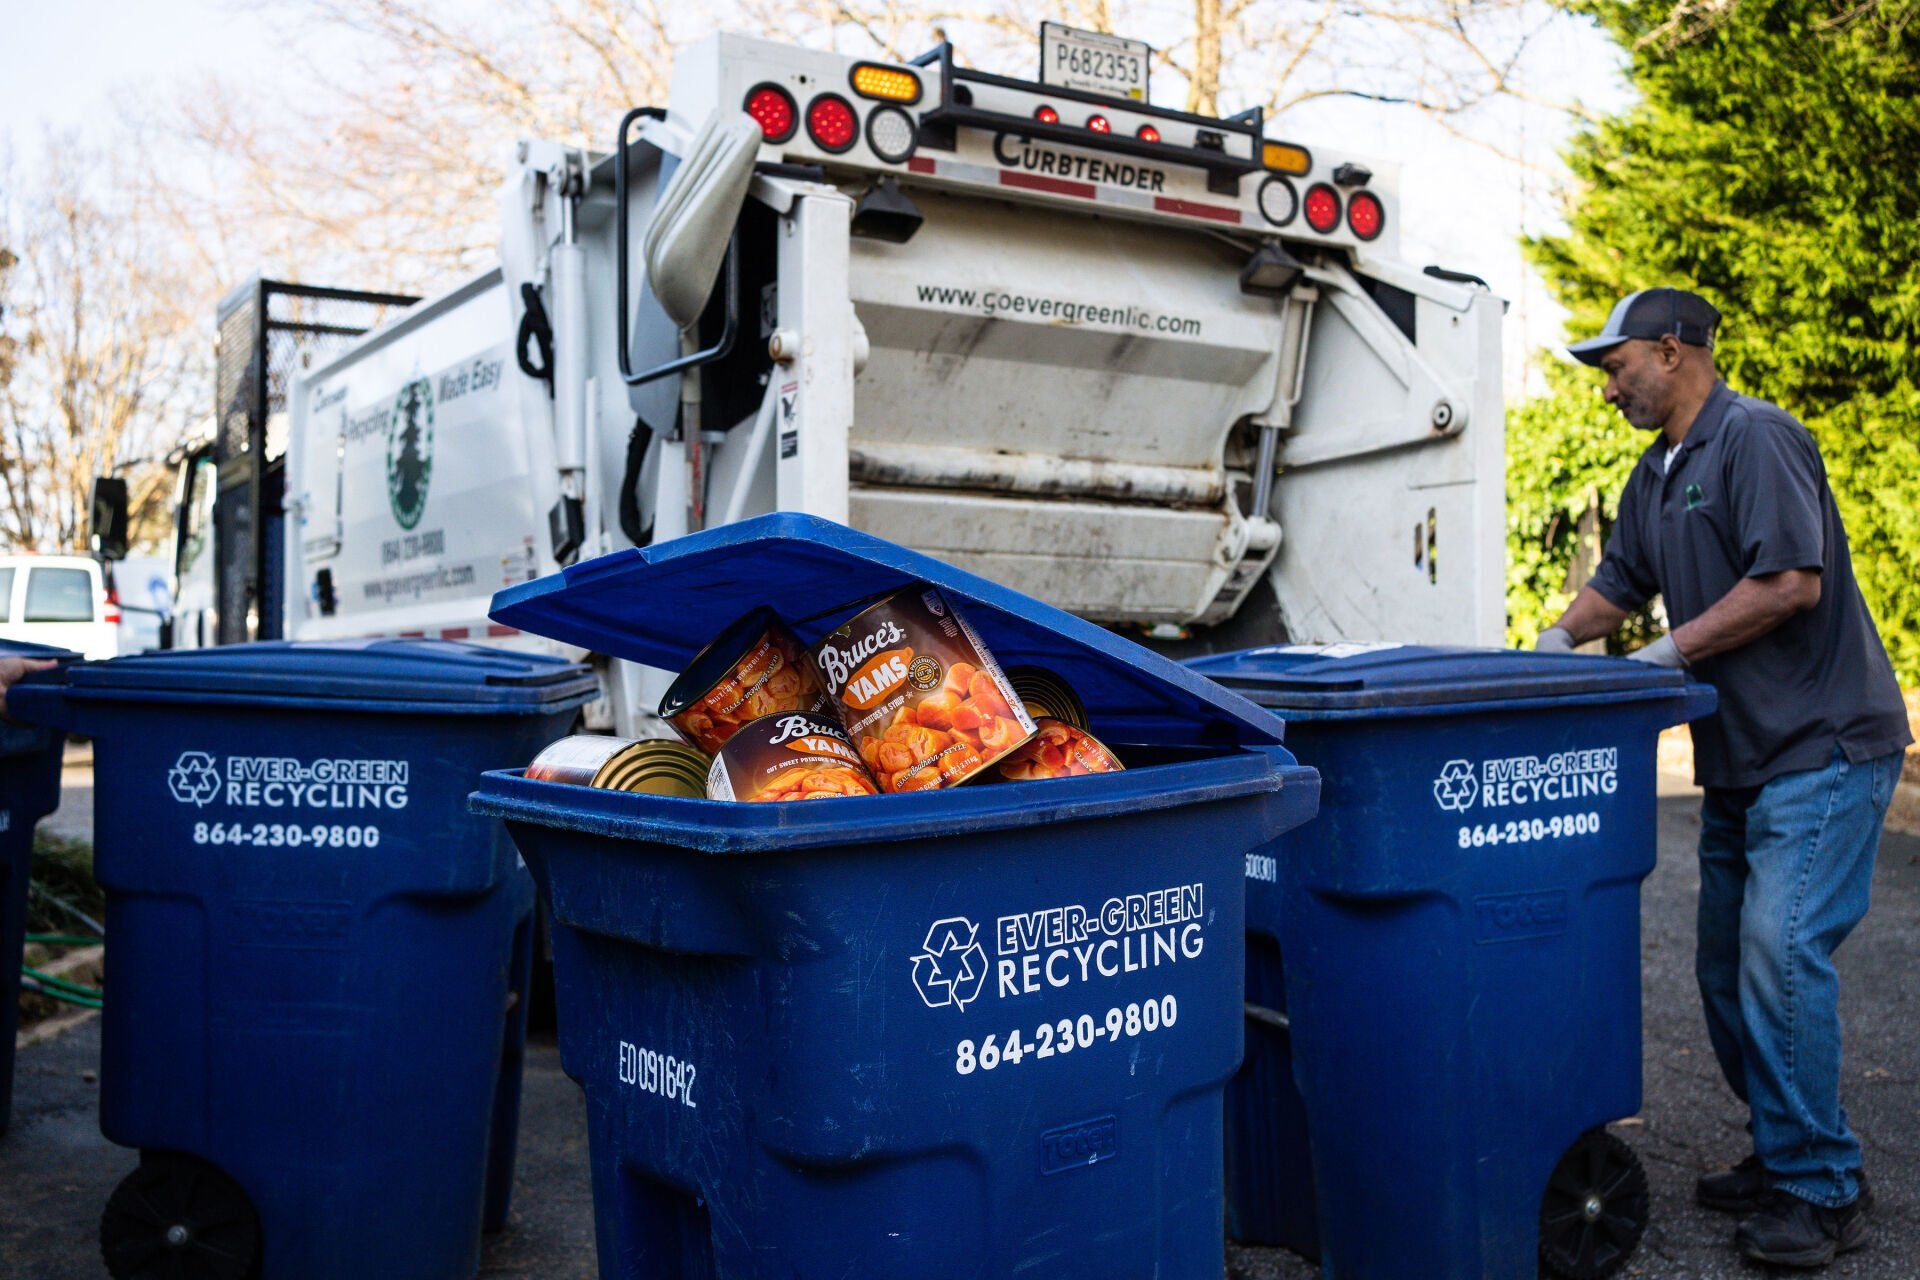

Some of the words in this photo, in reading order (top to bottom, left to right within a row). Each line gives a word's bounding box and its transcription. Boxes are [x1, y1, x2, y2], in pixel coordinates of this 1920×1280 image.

[1057, 43, 1139, 84] P682353
[993, 131, 1166, 192] CURBTENDER
[818, 621, 905, 695] Bruce's
[848, 656, 908, 704] YAMS
[887, 695, 906, 711] SYRUP
[769, 715, 852, 746] Bruc
[227, 756, 408, 785] EVER-GREEN
[1483, 747, 1617, 783] EVER-GREEN
[226, 781, 408, 809] RECYCLING
[1483, 770, 1618, 807] RECYCLING
[193, 821, 380, 848] 864-230-9800
[1458, 811, 1600, 849] 864-230-9800
[997, 883, 1203, 956] EVER-GREEN
[998, 923, 1204, 998] RECYCLING
[955, 994, 1178, 1076] 864-230-9800
